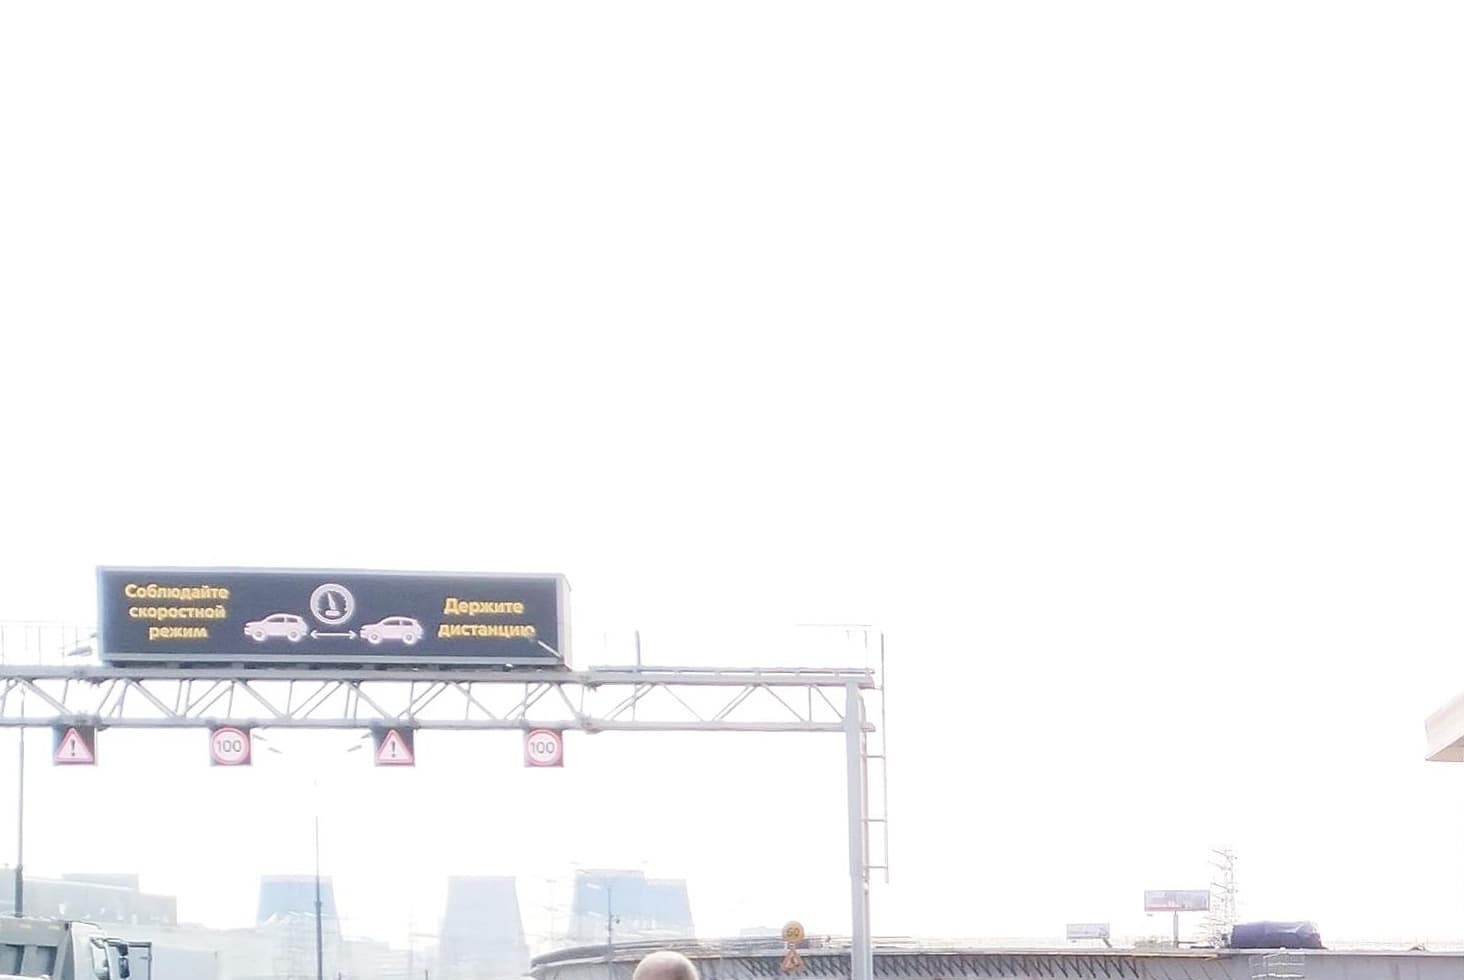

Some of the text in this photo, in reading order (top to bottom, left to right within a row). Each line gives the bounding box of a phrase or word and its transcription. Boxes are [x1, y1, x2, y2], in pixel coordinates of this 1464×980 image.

[125, 583, 230, 600] Соблюдайте
[128, 604, 227, 620] скоростной
[443, 597, 525, 616] Держите
[148, 626, 208, 640] режим
[438, 624, 537, 638] дистанцию
[217, 740, 242, 752] 100
[530, 741, 555, 753] 100
